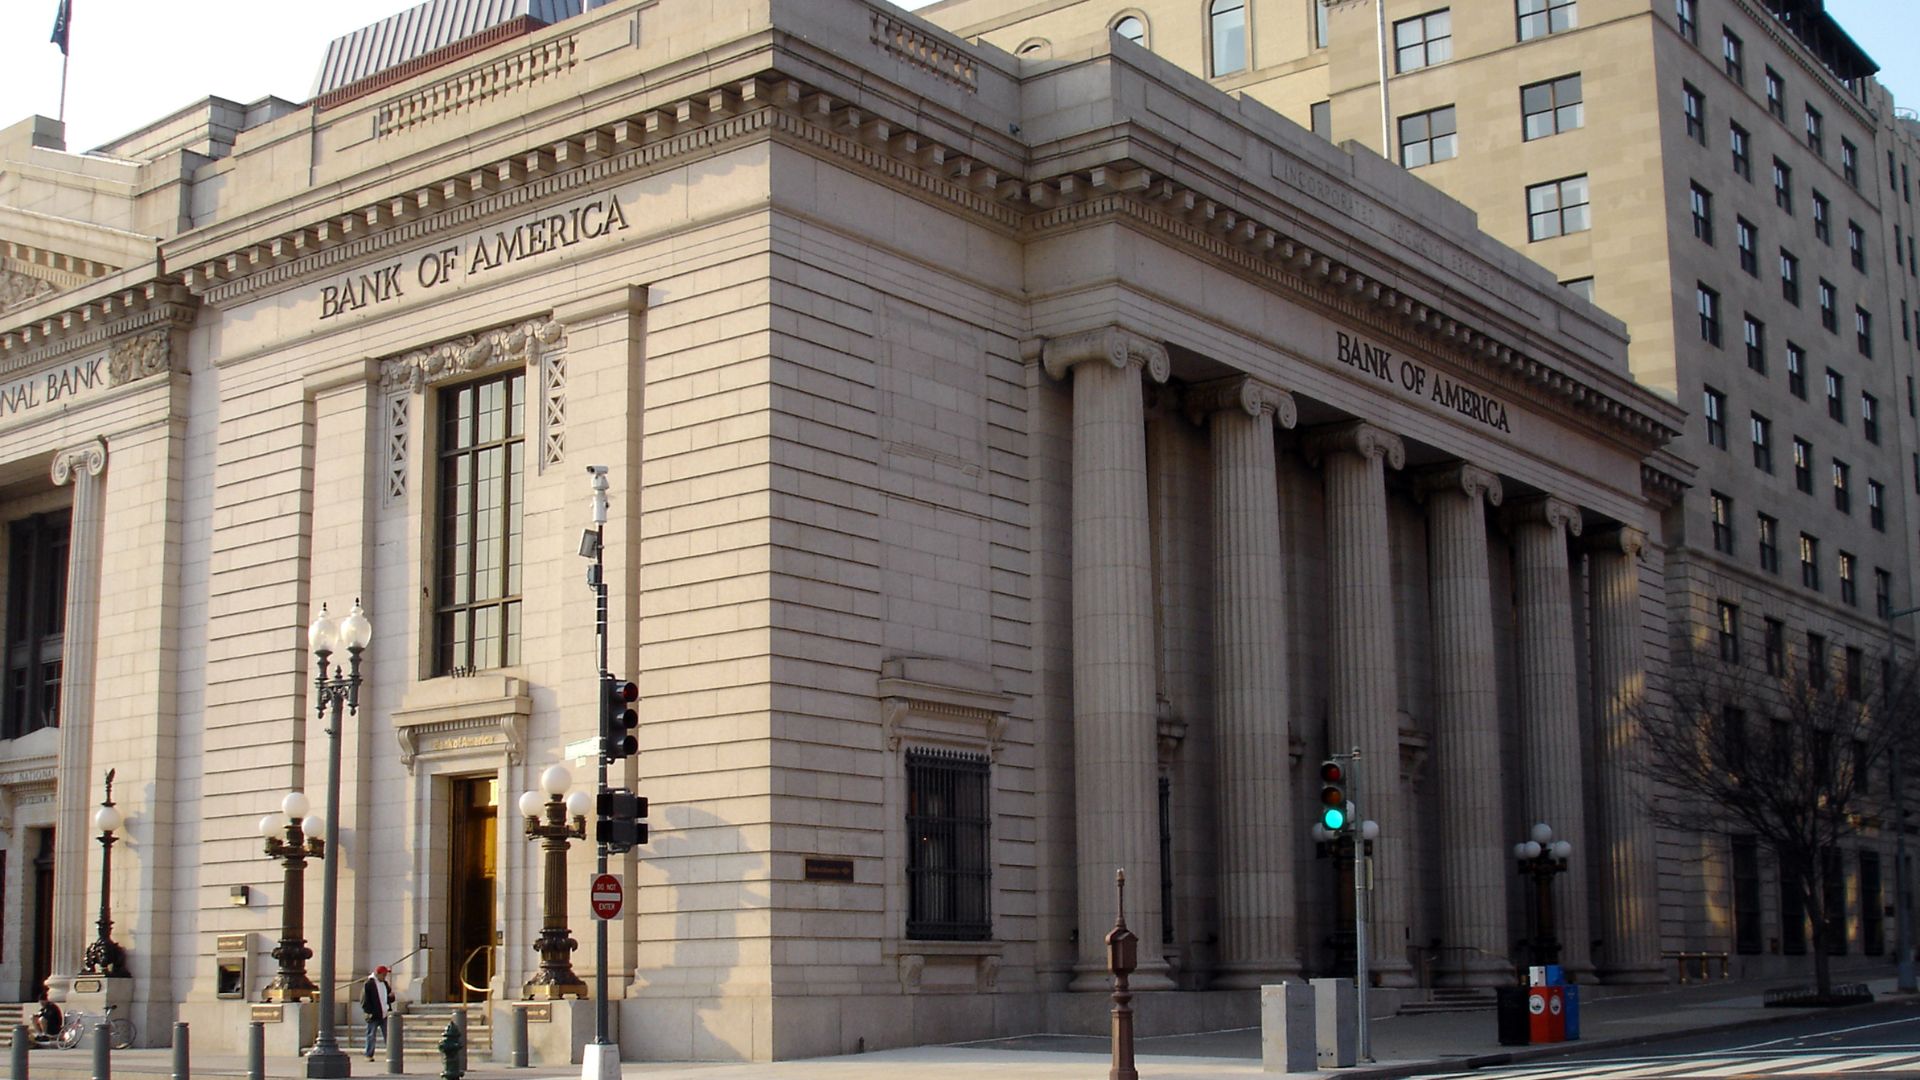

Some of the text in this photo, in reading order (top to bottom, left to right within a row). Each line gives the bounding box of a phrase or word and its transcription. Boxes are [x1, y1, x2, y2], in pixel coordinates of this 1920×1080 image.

[319, 193, 629, 320] BANK OF AMERICA
[0, 357, 104, 416] NAL BANK
[1336, 331, 1511, 434] BANK OF AMERICA
